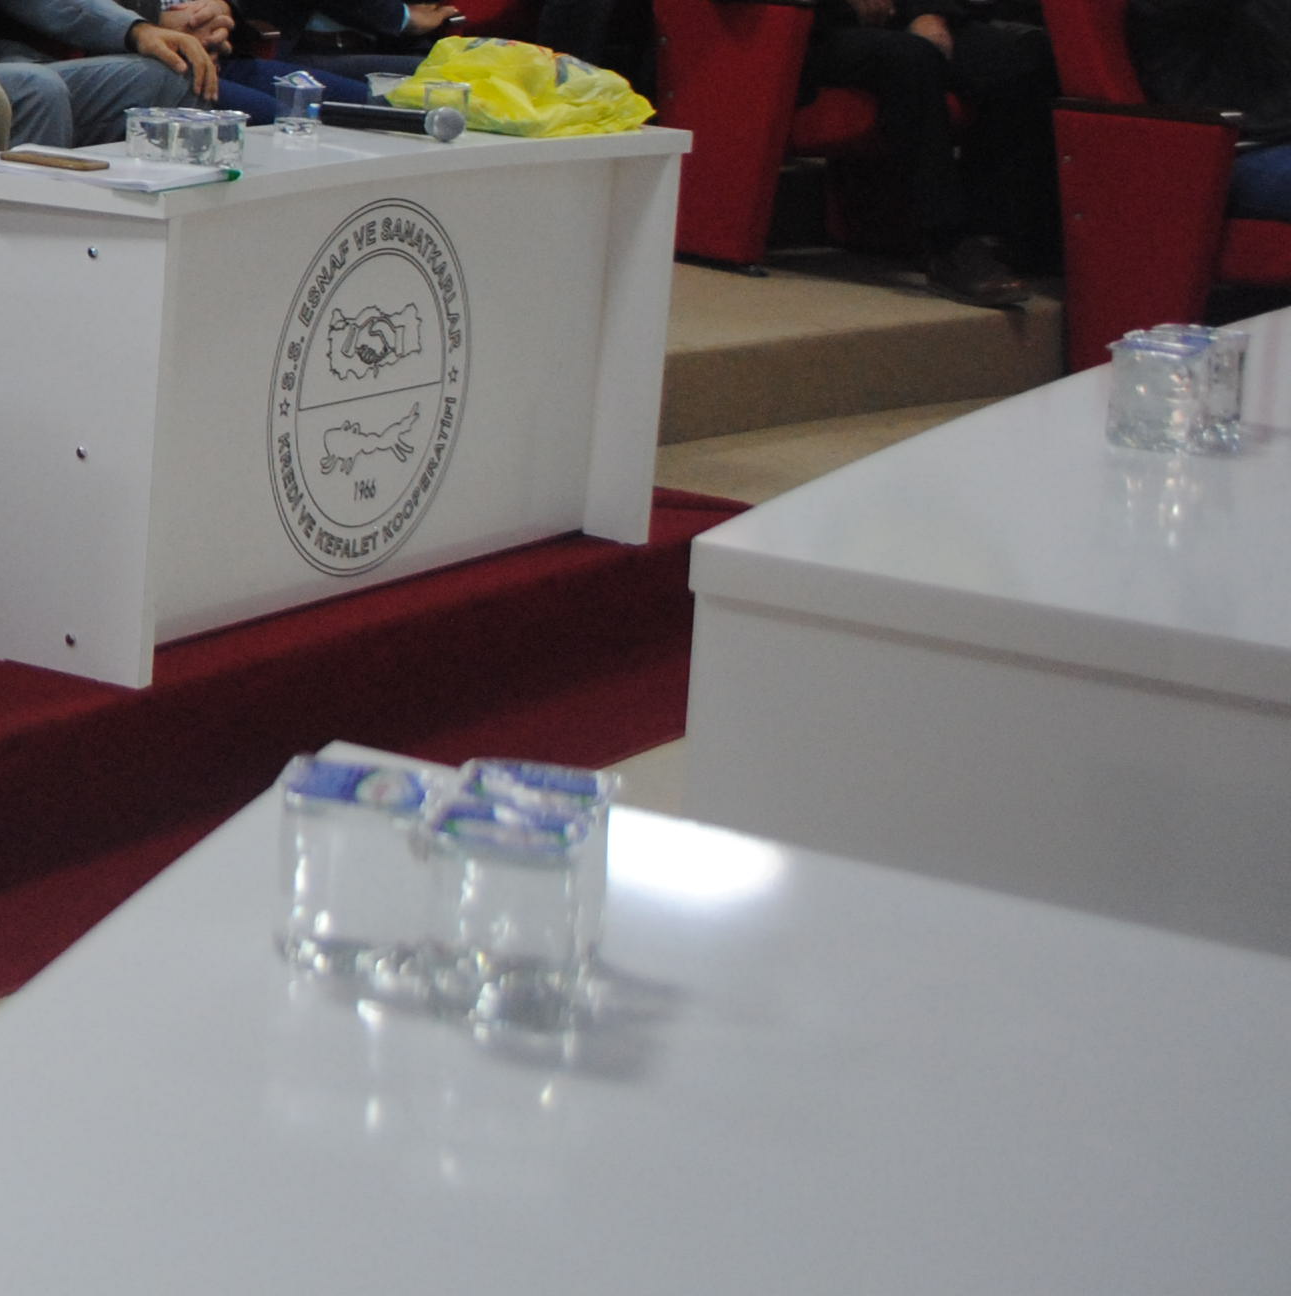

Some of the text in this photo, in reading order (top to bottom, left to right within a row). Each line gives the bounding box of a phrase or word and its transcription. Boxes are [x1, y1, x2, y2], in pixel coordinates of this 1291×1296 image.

[298, 239, 349, 328] ESNAF
[352, 220, 377, 251] VE
[381, 217, 461, 353] SANATKARLAR
[354, 478, 377, 501] 1966
[298, 505, 317, 539] VE
[314, 527, 379, 558] KEFALET
